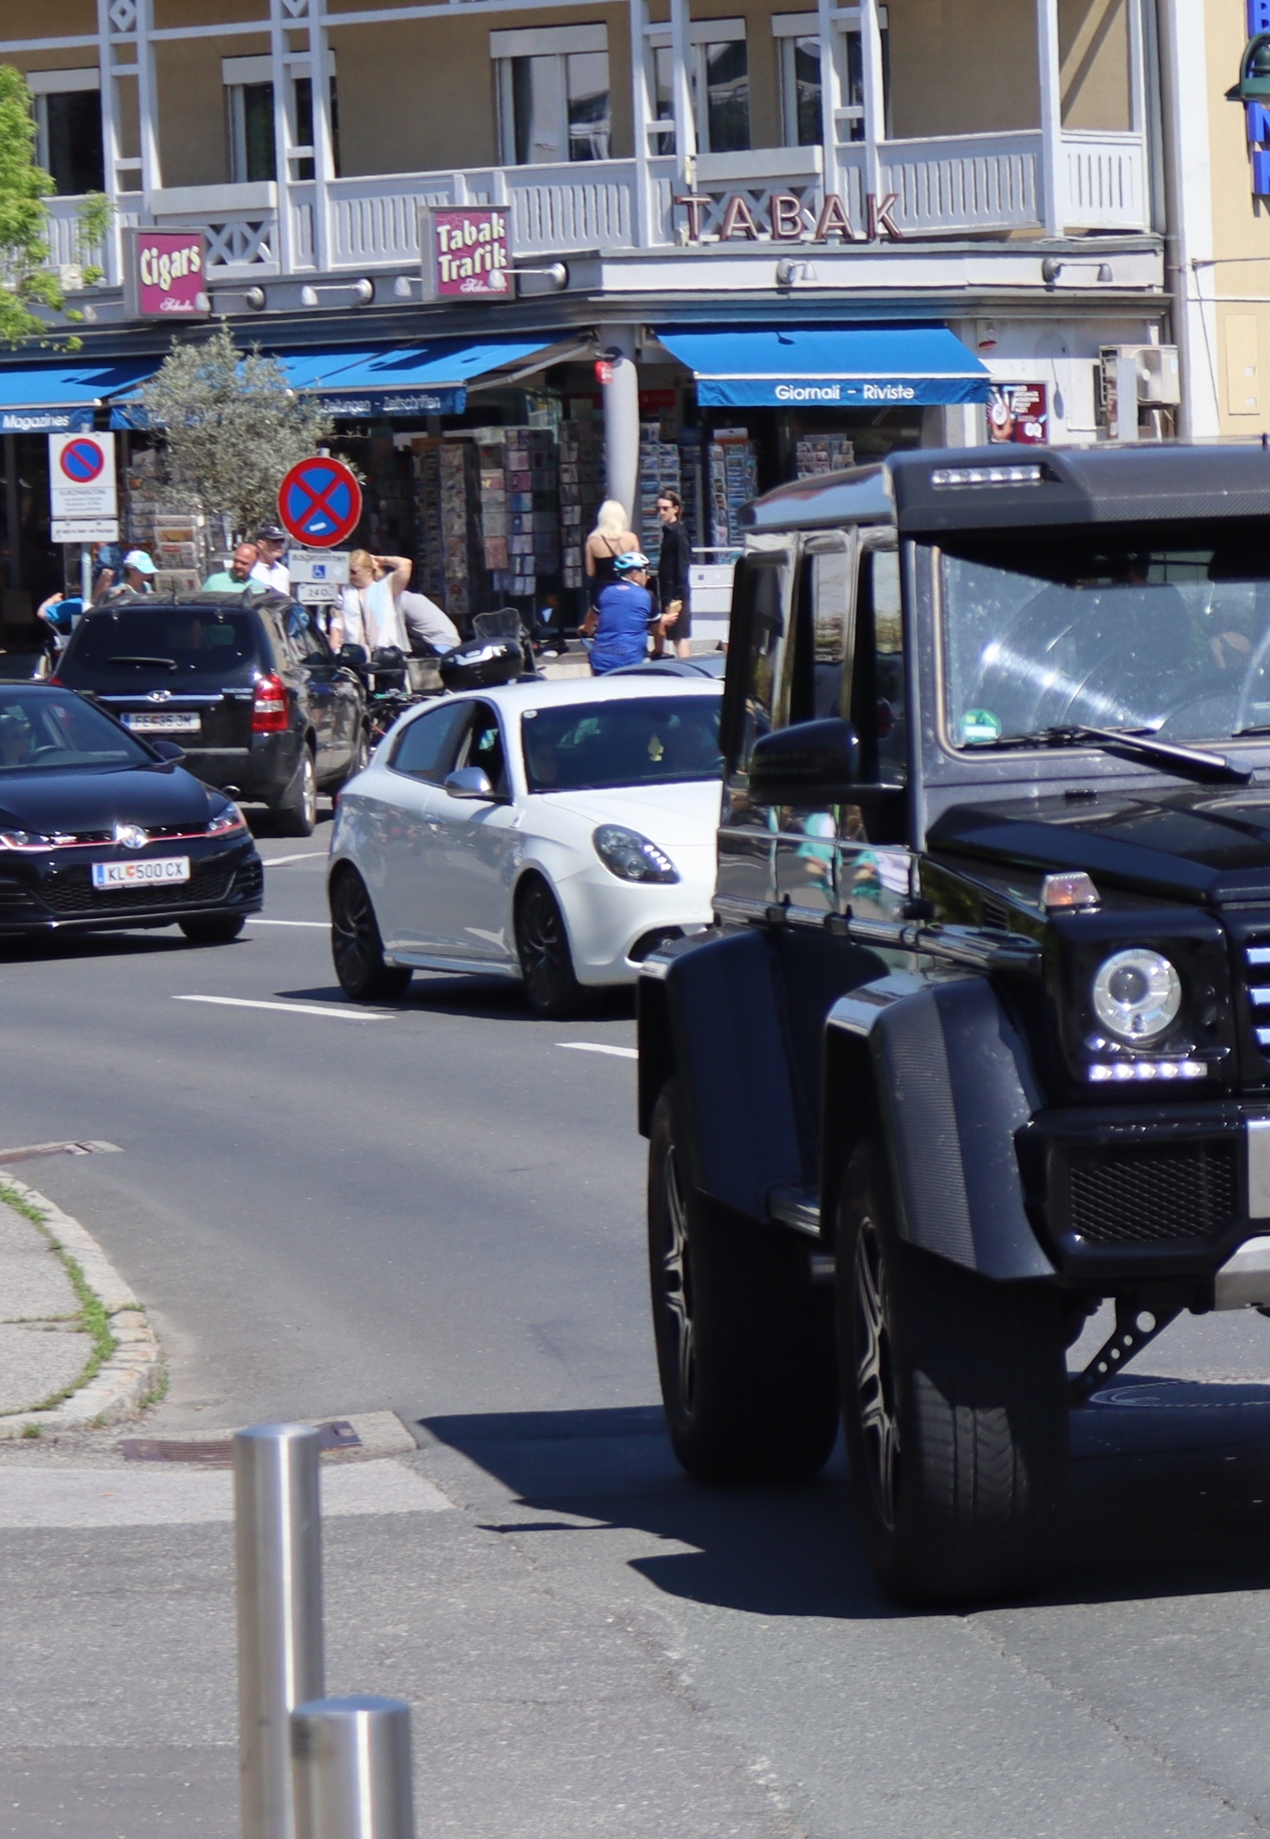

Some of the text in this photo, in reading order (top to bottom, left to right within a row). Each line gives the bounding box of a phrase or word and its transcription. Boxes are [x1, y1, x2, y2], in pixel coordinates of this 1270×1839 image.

[437, 212, 505, 252] Tabak
[675, 193, 903, 241] TABAK
[140, 245, 201, 291] Cigars
[438, 242, 507, 282] Trafik
[322, 398, 372, 415] Zeitungen
[382, 394, 441, 411] Zeitschriften
[775, 384, 841, 400] Giornali
[863, 384, 915, 399] Riviste
[2, 413, 71, 430] Magazines
[108, 862, 183, 881] KL 500 CX
